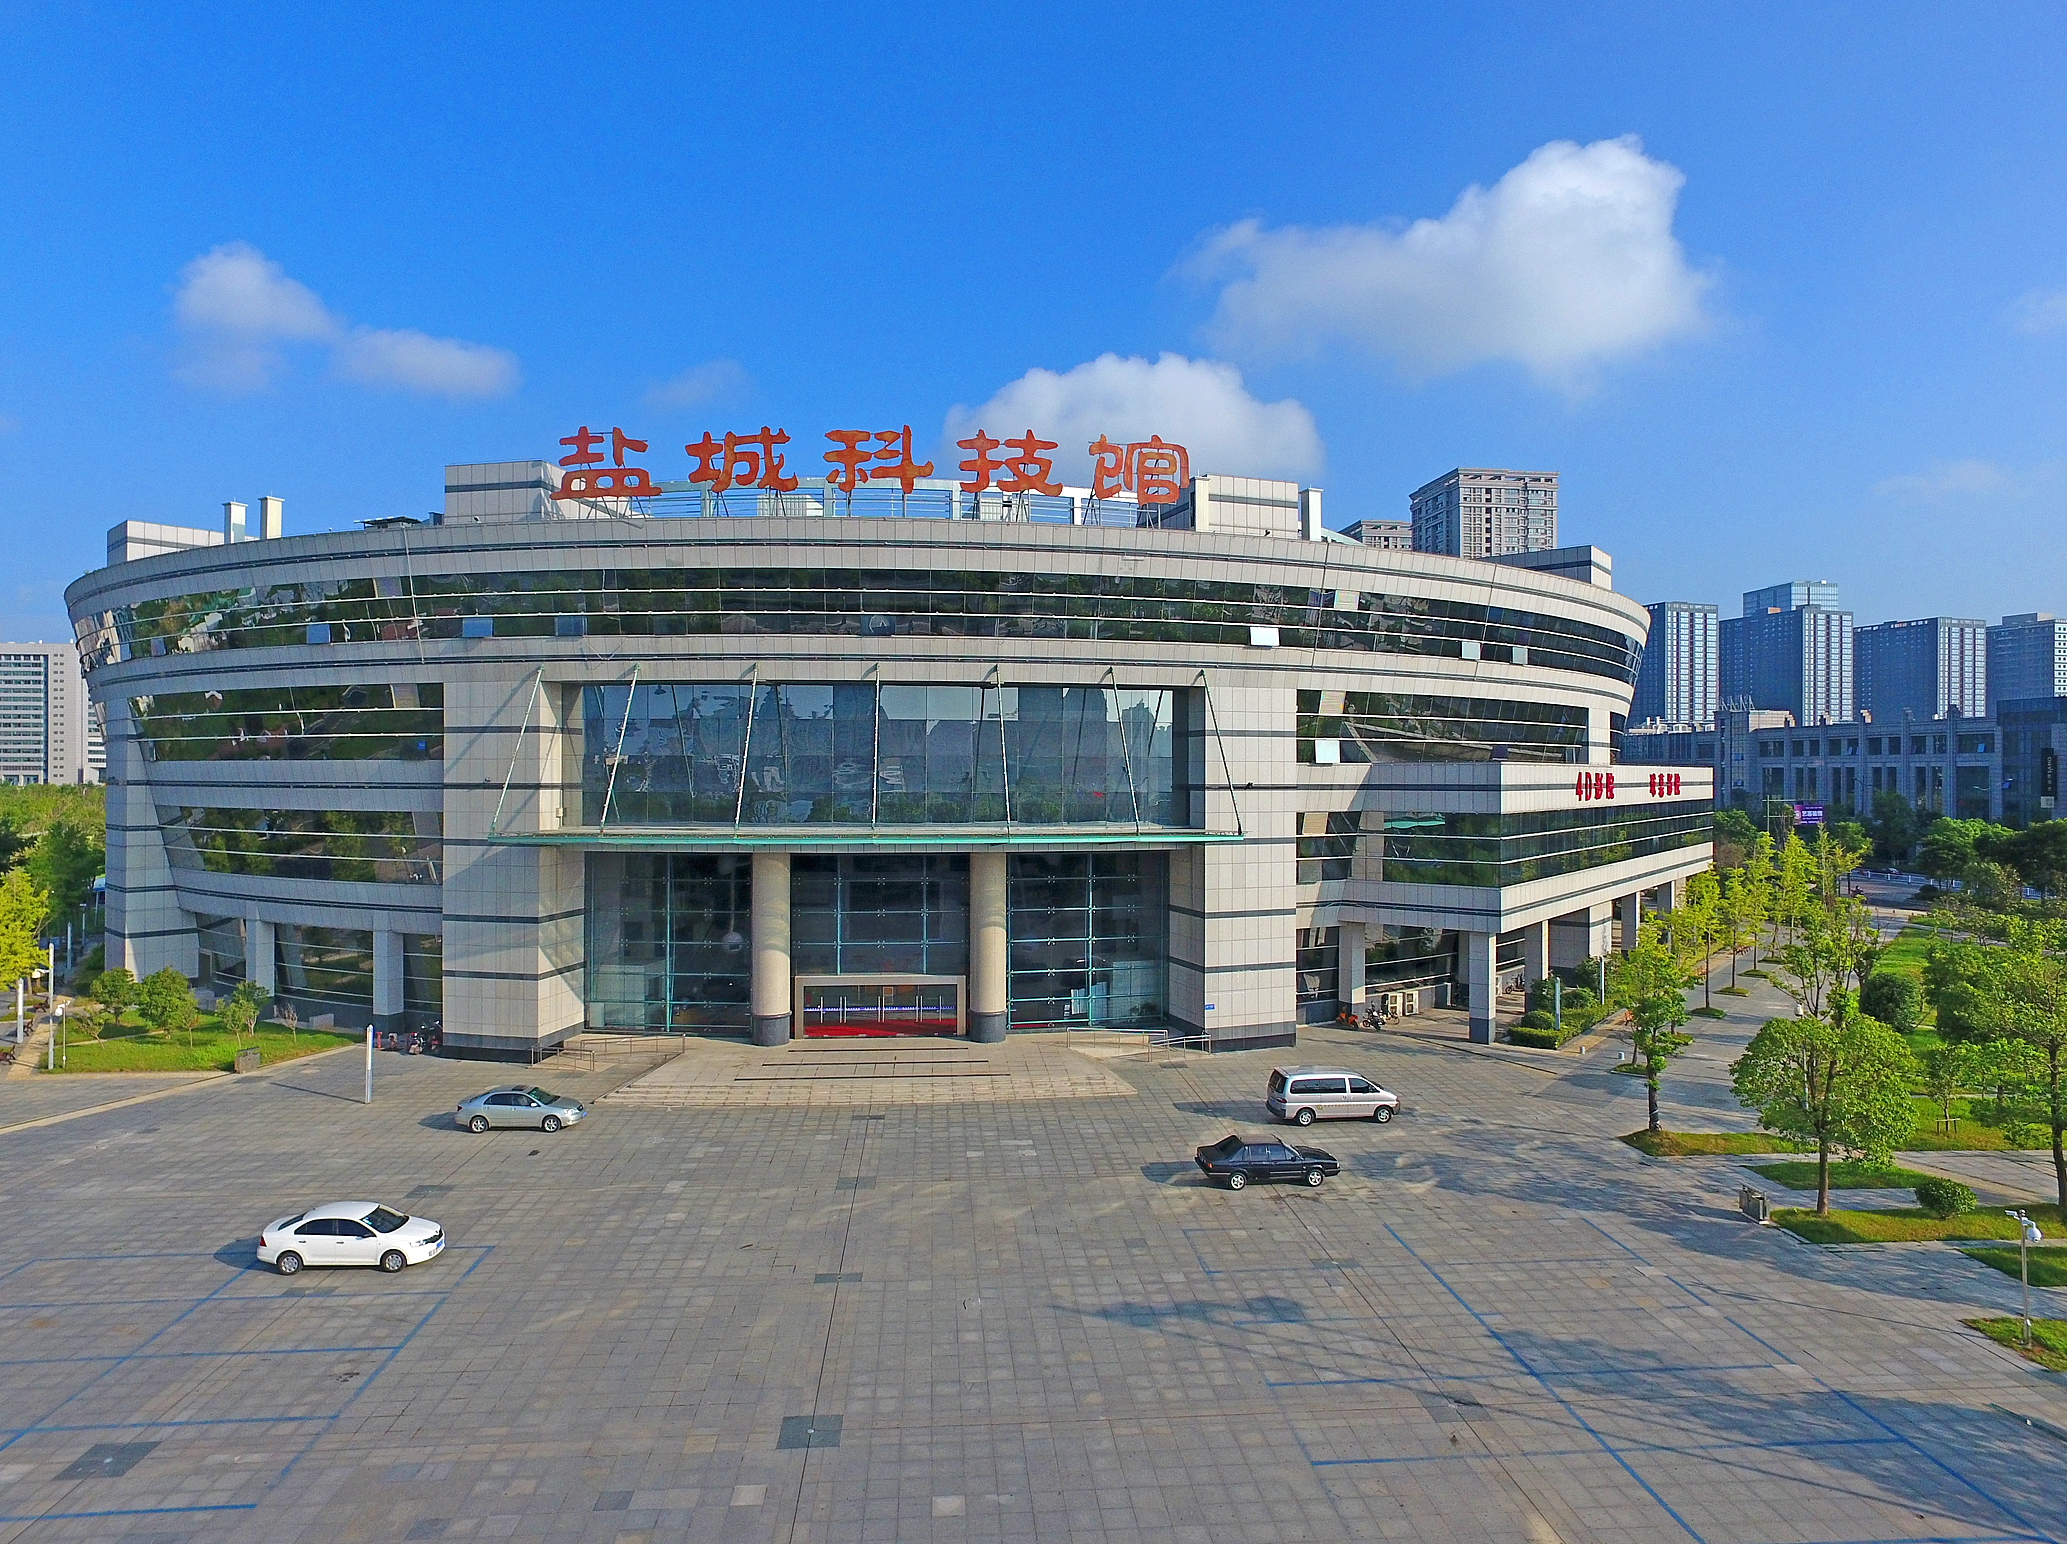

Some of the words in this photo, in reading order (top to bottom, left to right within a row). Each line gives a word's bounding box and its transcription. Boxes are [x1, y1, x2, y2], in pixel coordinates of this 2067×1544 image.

[550, 425, 1190, 504] 盐城科技馆
[1576, 771, 1616, 801] 4D影院
